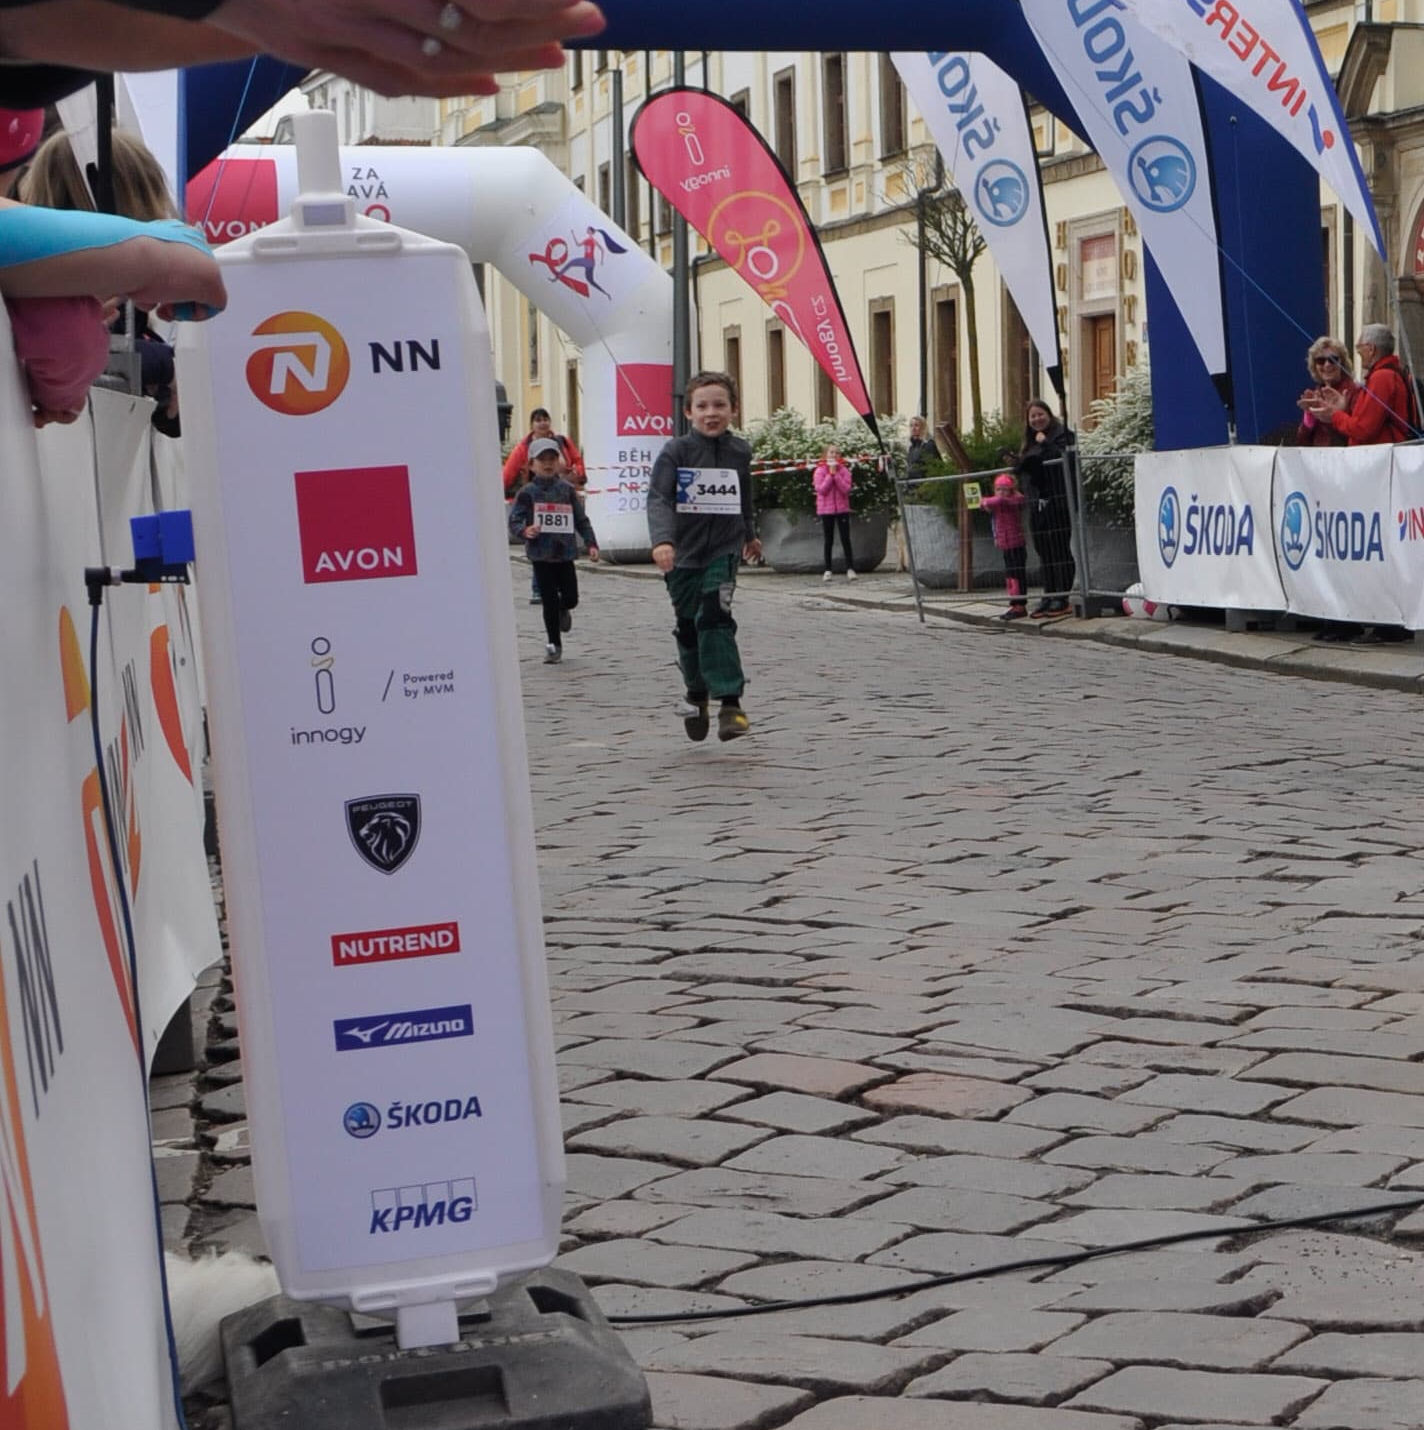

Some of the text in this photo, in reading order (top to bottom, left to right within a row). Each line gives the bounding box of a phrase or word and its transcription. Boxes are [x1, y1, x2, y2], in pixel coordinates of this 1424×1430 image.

[352, 167, 380, 181] ZA
[367, 338, 441, 375] NN
[696, 483, 737, 497] 3444
[537, 513, 569, 527] 1881
[1183, 494, 1255, 557] ŠKODA
[1314, 500, 1386, 563] ŠKODA
[314, 546, 405, 574] AVON
[403, 670, 455, 684] Powered
[404, 684, 455, 699] by MVM
[290, 725, 367, 746] innogy
[338, 929, 454, 959] NUTREND
[386, 1095, 483, 1130] ŠKODA
[369, 1196, 474, 1235] KPMG
